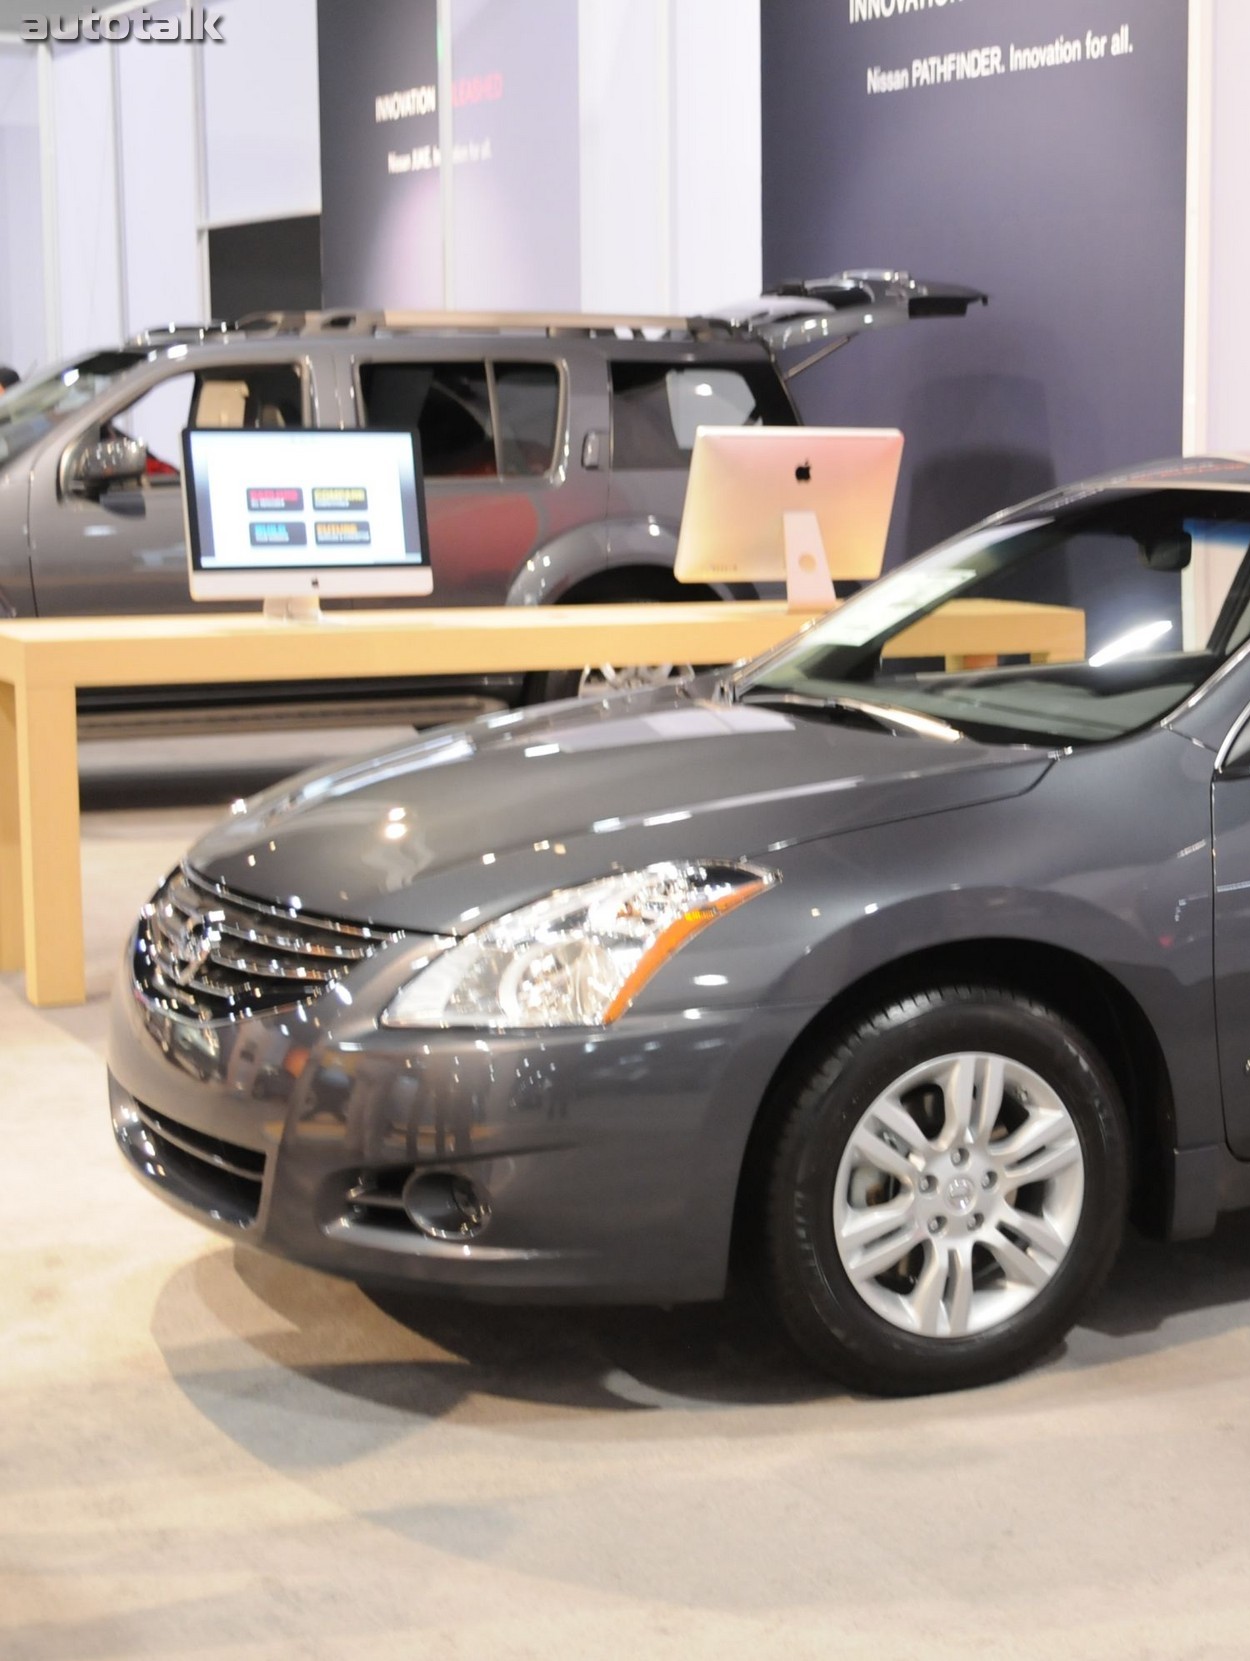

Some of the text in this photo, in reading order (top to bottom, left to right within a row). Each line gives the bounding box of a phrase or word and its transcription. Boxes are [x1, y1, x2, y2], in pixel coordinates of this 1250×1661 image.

[867, 23, 1133, 94] Nissan PATHFINDER. Innovation for all.
[375, 85, 437, 123] INNOVATION
